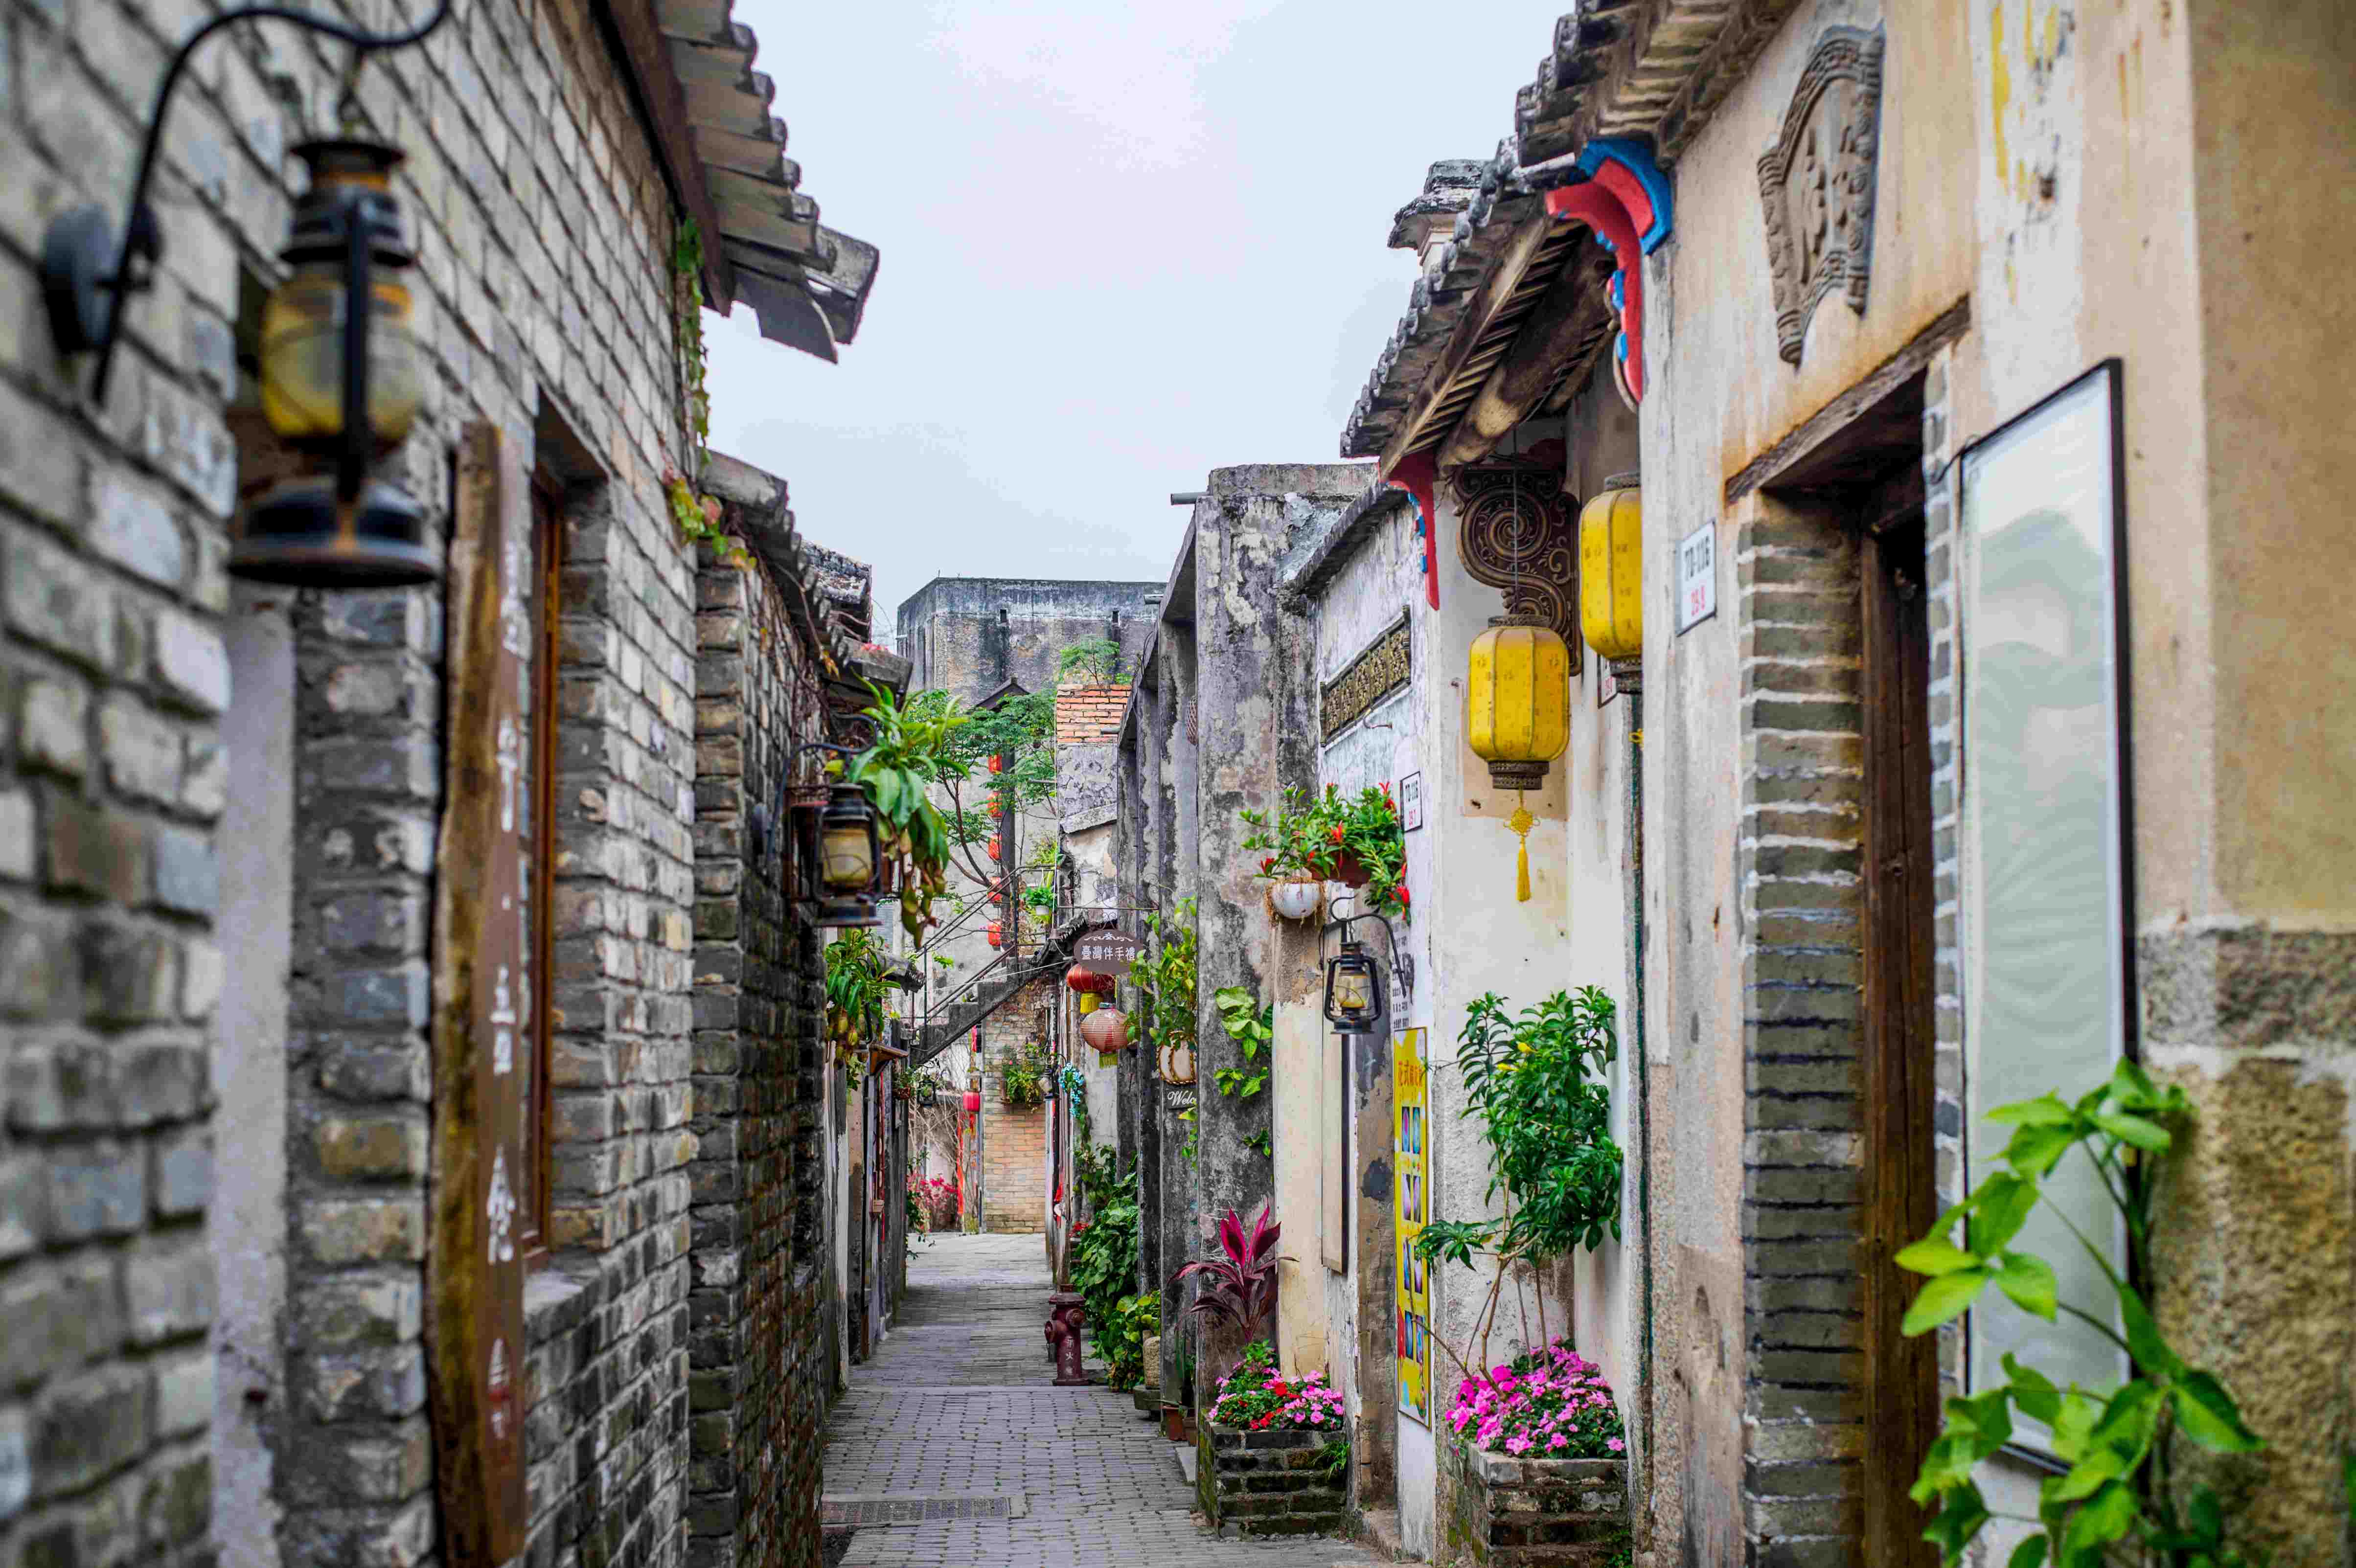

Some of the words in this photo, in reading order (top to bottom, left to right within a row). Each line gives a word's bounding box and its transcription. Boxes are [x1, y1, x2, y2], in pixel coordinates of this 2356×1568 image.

[1081, 945, 1135, 961] 臺灣伴手禮
